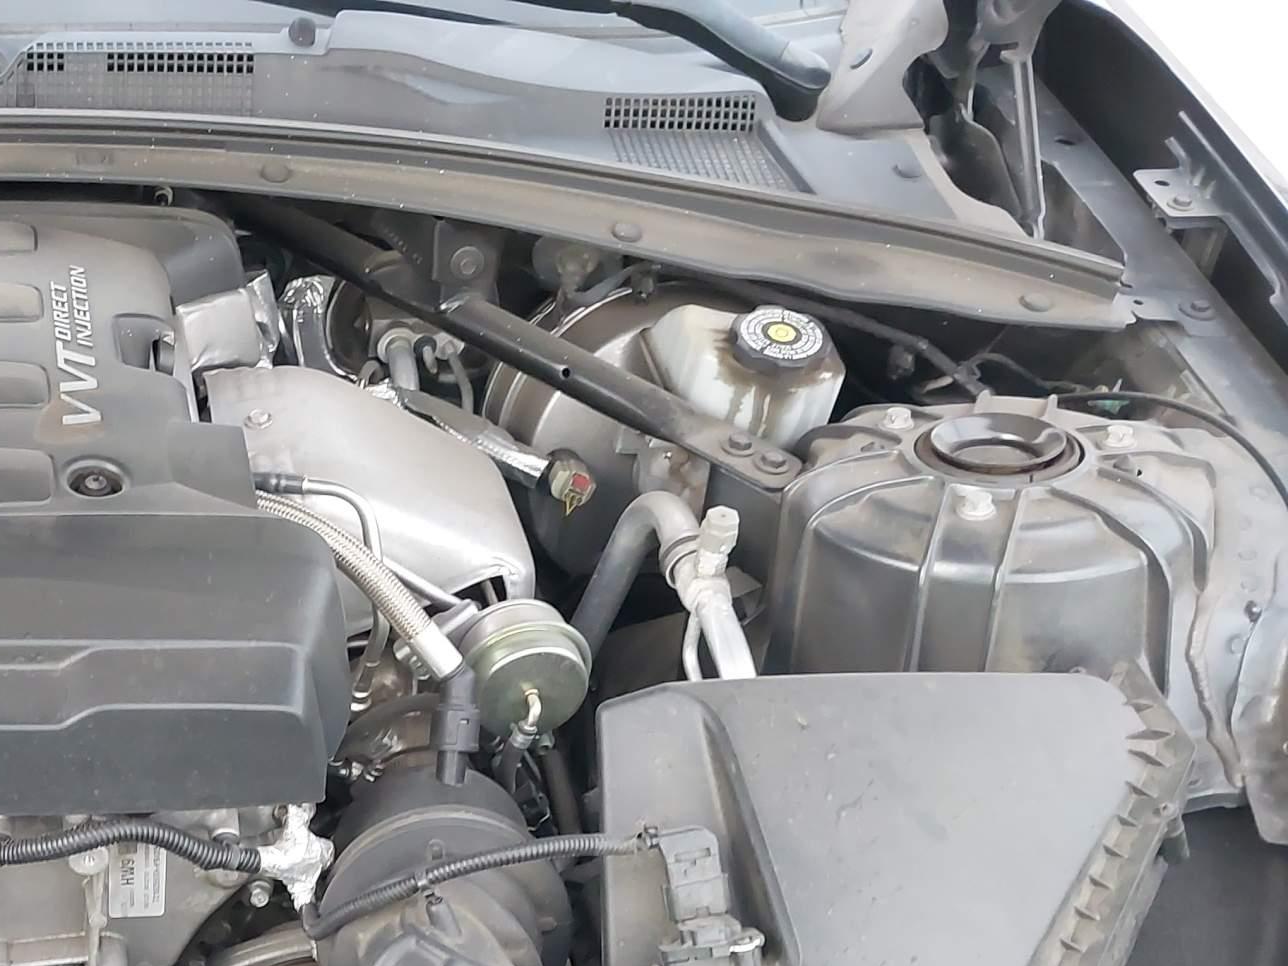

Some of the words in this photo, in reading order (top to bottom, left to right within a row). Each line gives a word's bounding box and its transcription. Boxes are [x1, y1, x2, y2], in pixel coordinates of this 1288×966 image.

[50, 281, 72, 341] DIRECT
[68, 265, 94, 348] INJECTION
[55, 340, 102, 425] VVT
